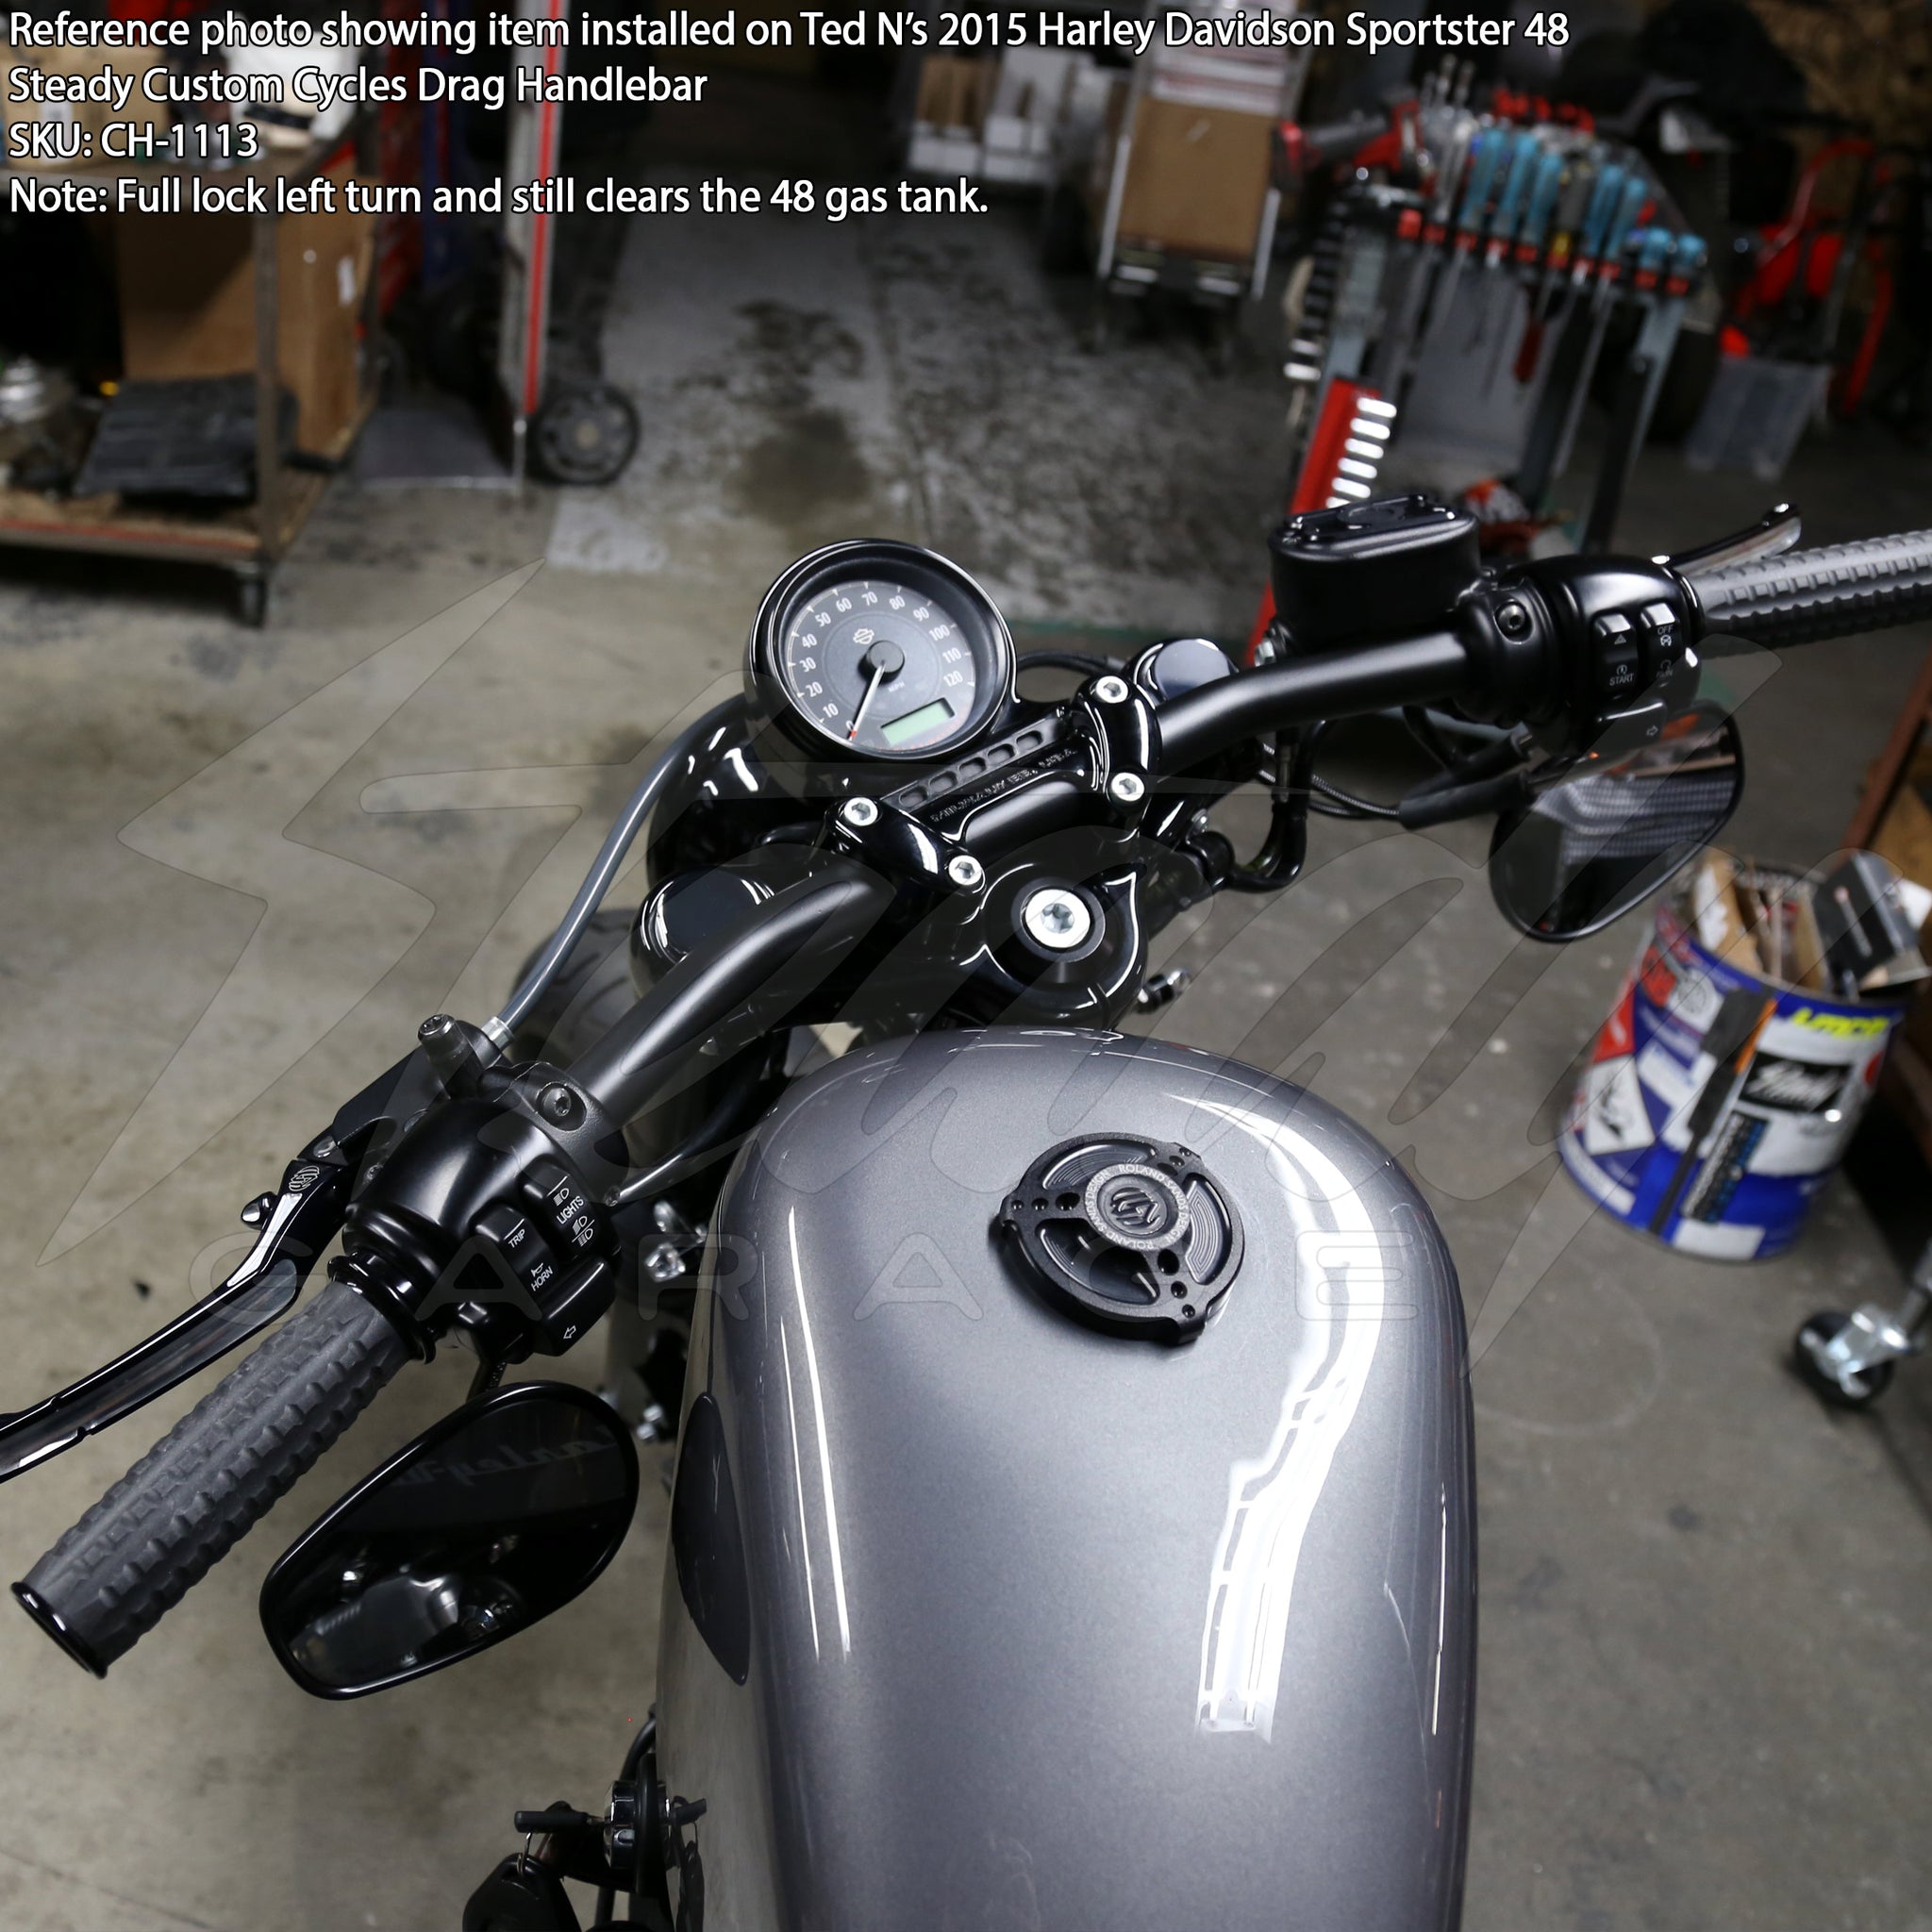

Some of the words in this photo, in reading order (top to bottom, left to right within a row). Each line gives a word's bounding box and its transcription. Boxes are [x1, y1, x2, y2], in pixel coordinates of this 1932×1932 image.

[836, 597, 852, 612] 60
[861, 591, 877, 606] 70
[889, 595, 906, 610] 80
[815, 611, 831, 627] 50
[913, 607, 929, 622] 90
[929, 625, 950, 641] 100
[1657, 625, 1674, 635] OFF
[802, 634, 817, 648] 40
[942, 647, 962, 663] 110
[800, 657, 816, 673] 30
[943, 671, 963, 687] 120
[1609, 673, 1634, 686] START
[806, 681, 823, 697] 20
[823, 703, 839, 719] 10
[1118, 1163, 1166, 1182] ROLAND
[1086, 1170, 1110, 1200] DESIGN
[1163, 1180, 1189, 1210] SANDS
[557, 1195, 585, 1224] LIGHTS
[1085, 1200, 1108, 1232] SANDS
[1165, 1211, 1190, 1243] DESIGN
[508, 1229, 525, 1248] TRIP
[1105, 1229, 1155, 1250] ROLAND
[531, 1266, 553, 1291] HORN
